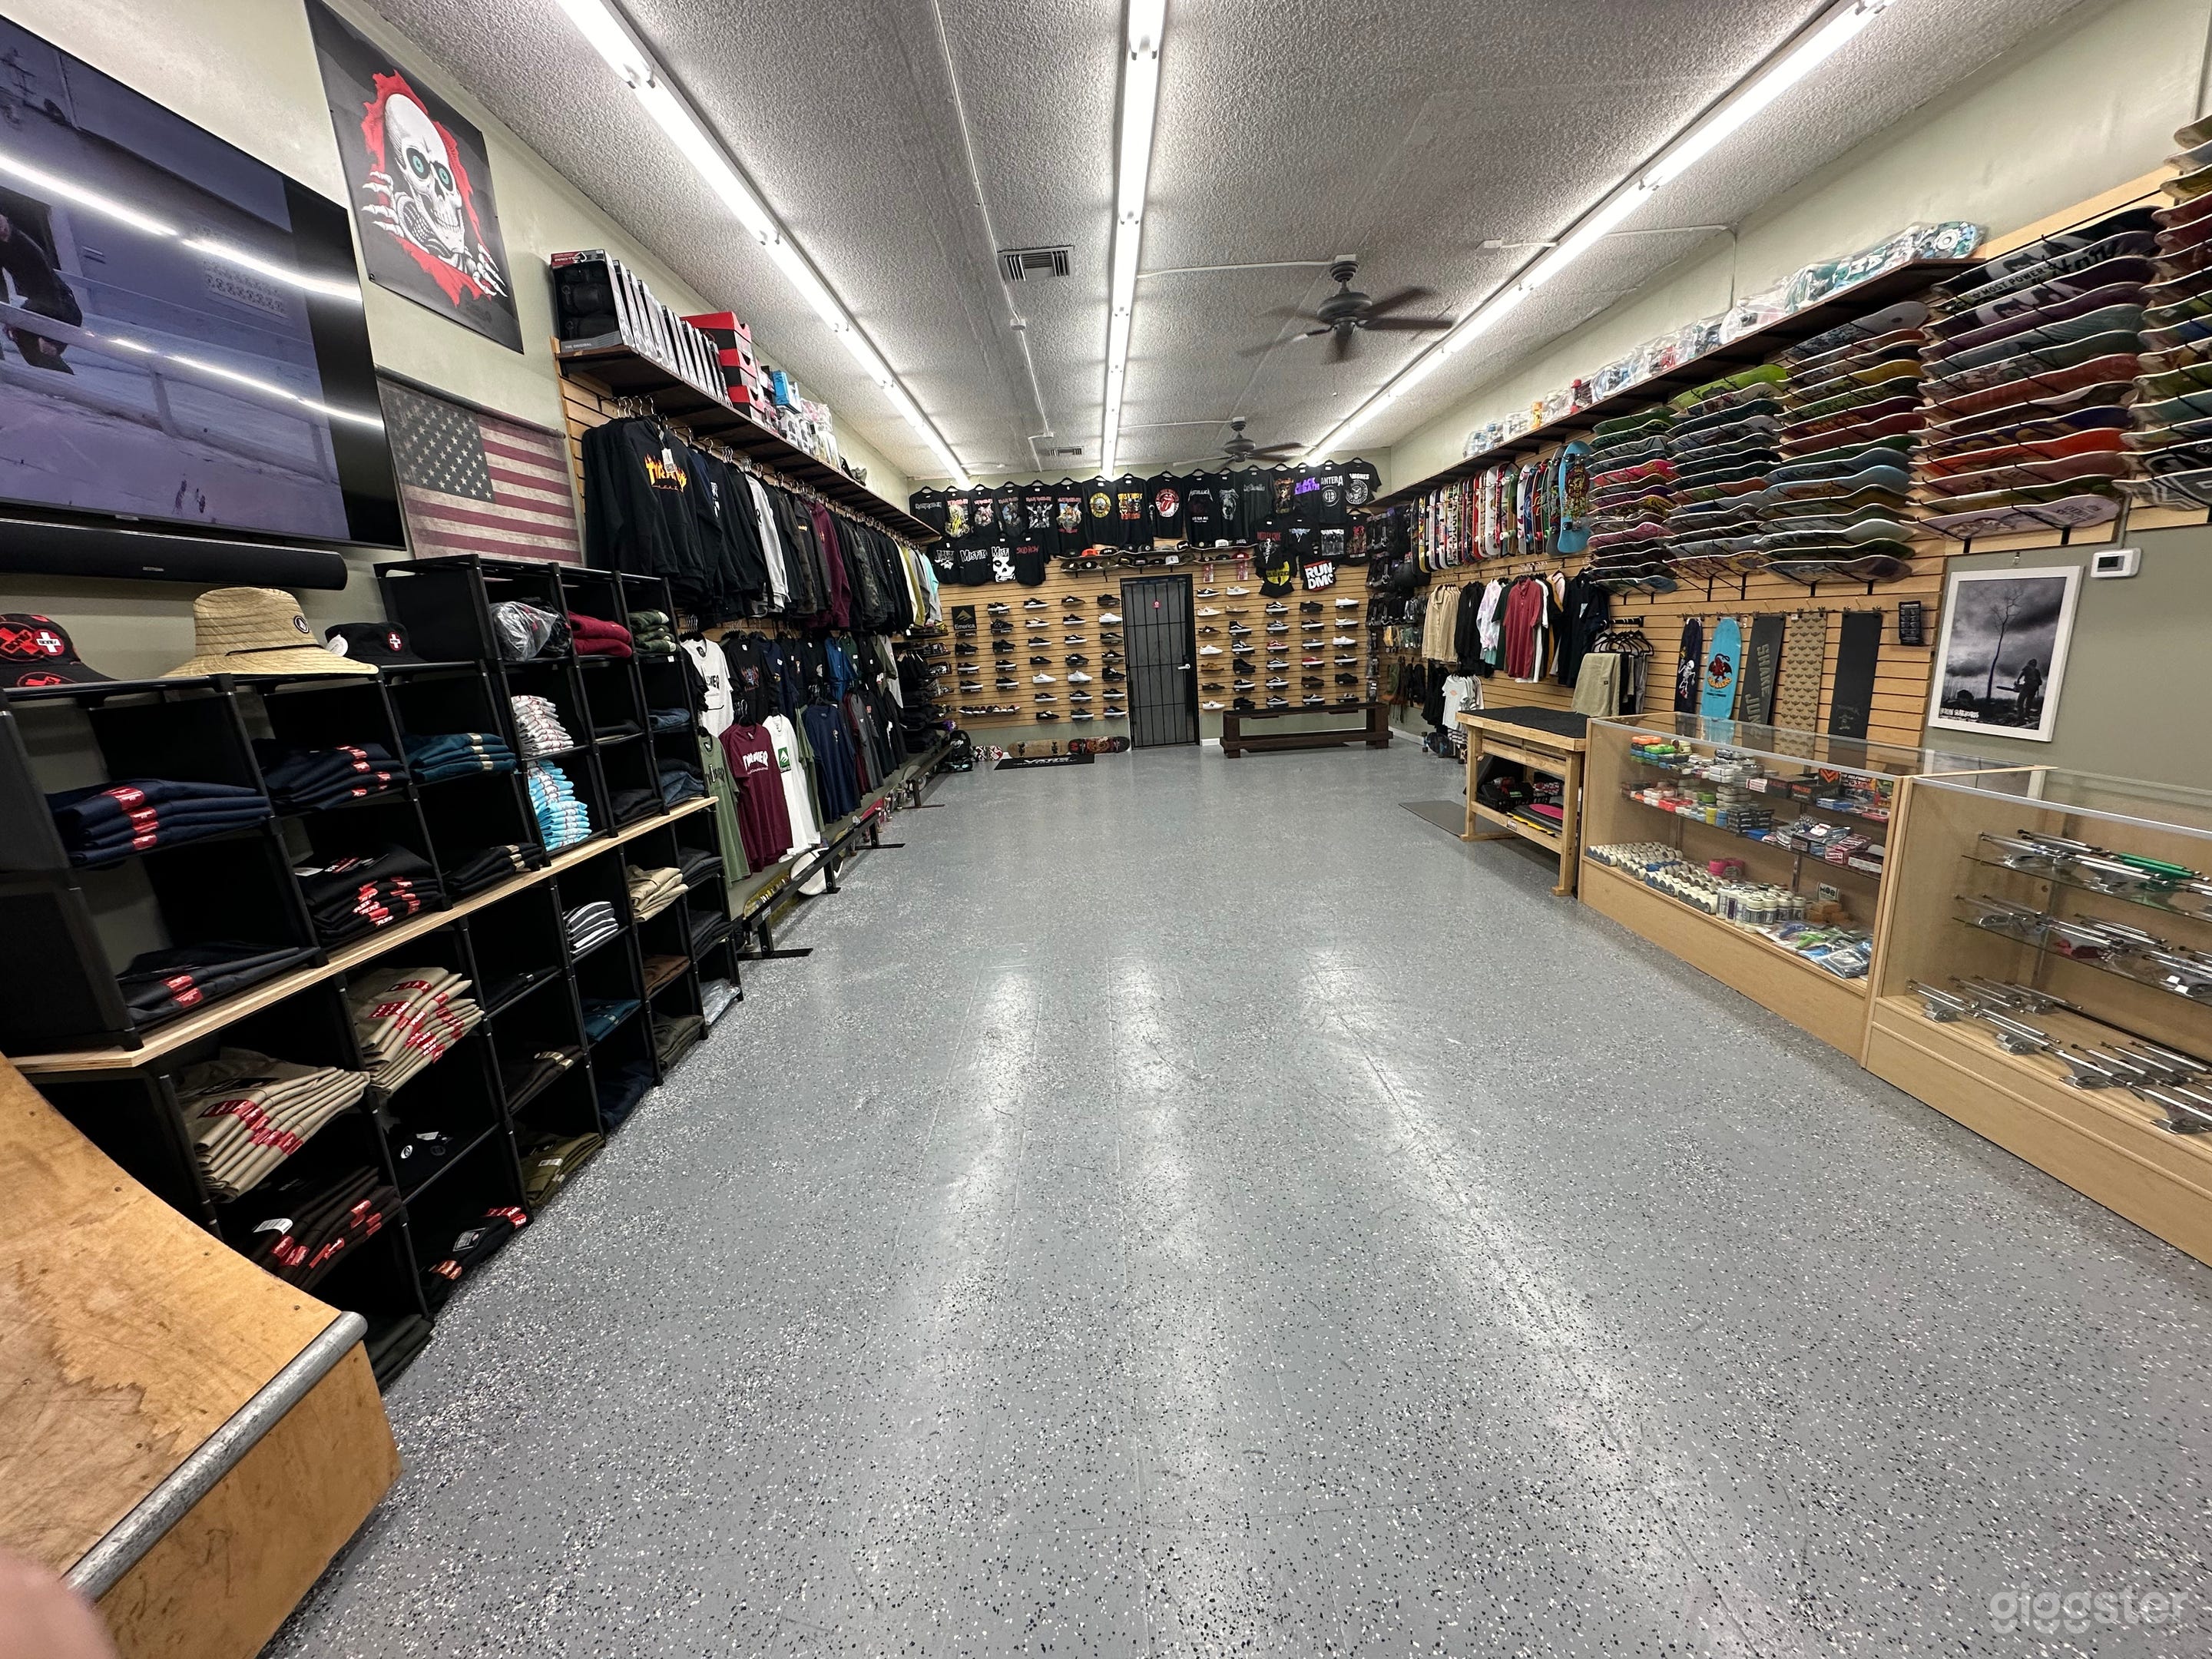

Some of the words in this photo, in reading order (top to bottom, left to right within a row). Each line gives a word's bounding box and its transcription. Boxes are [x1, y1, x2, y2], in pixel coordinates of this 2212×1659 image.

[1982, 281, 2010, 296] MOST
[2009, 267, 2047, 286] POWER
[1320, 475, 1344, 487] ANTERA
[1307, 573, 1334, 590] DMC
